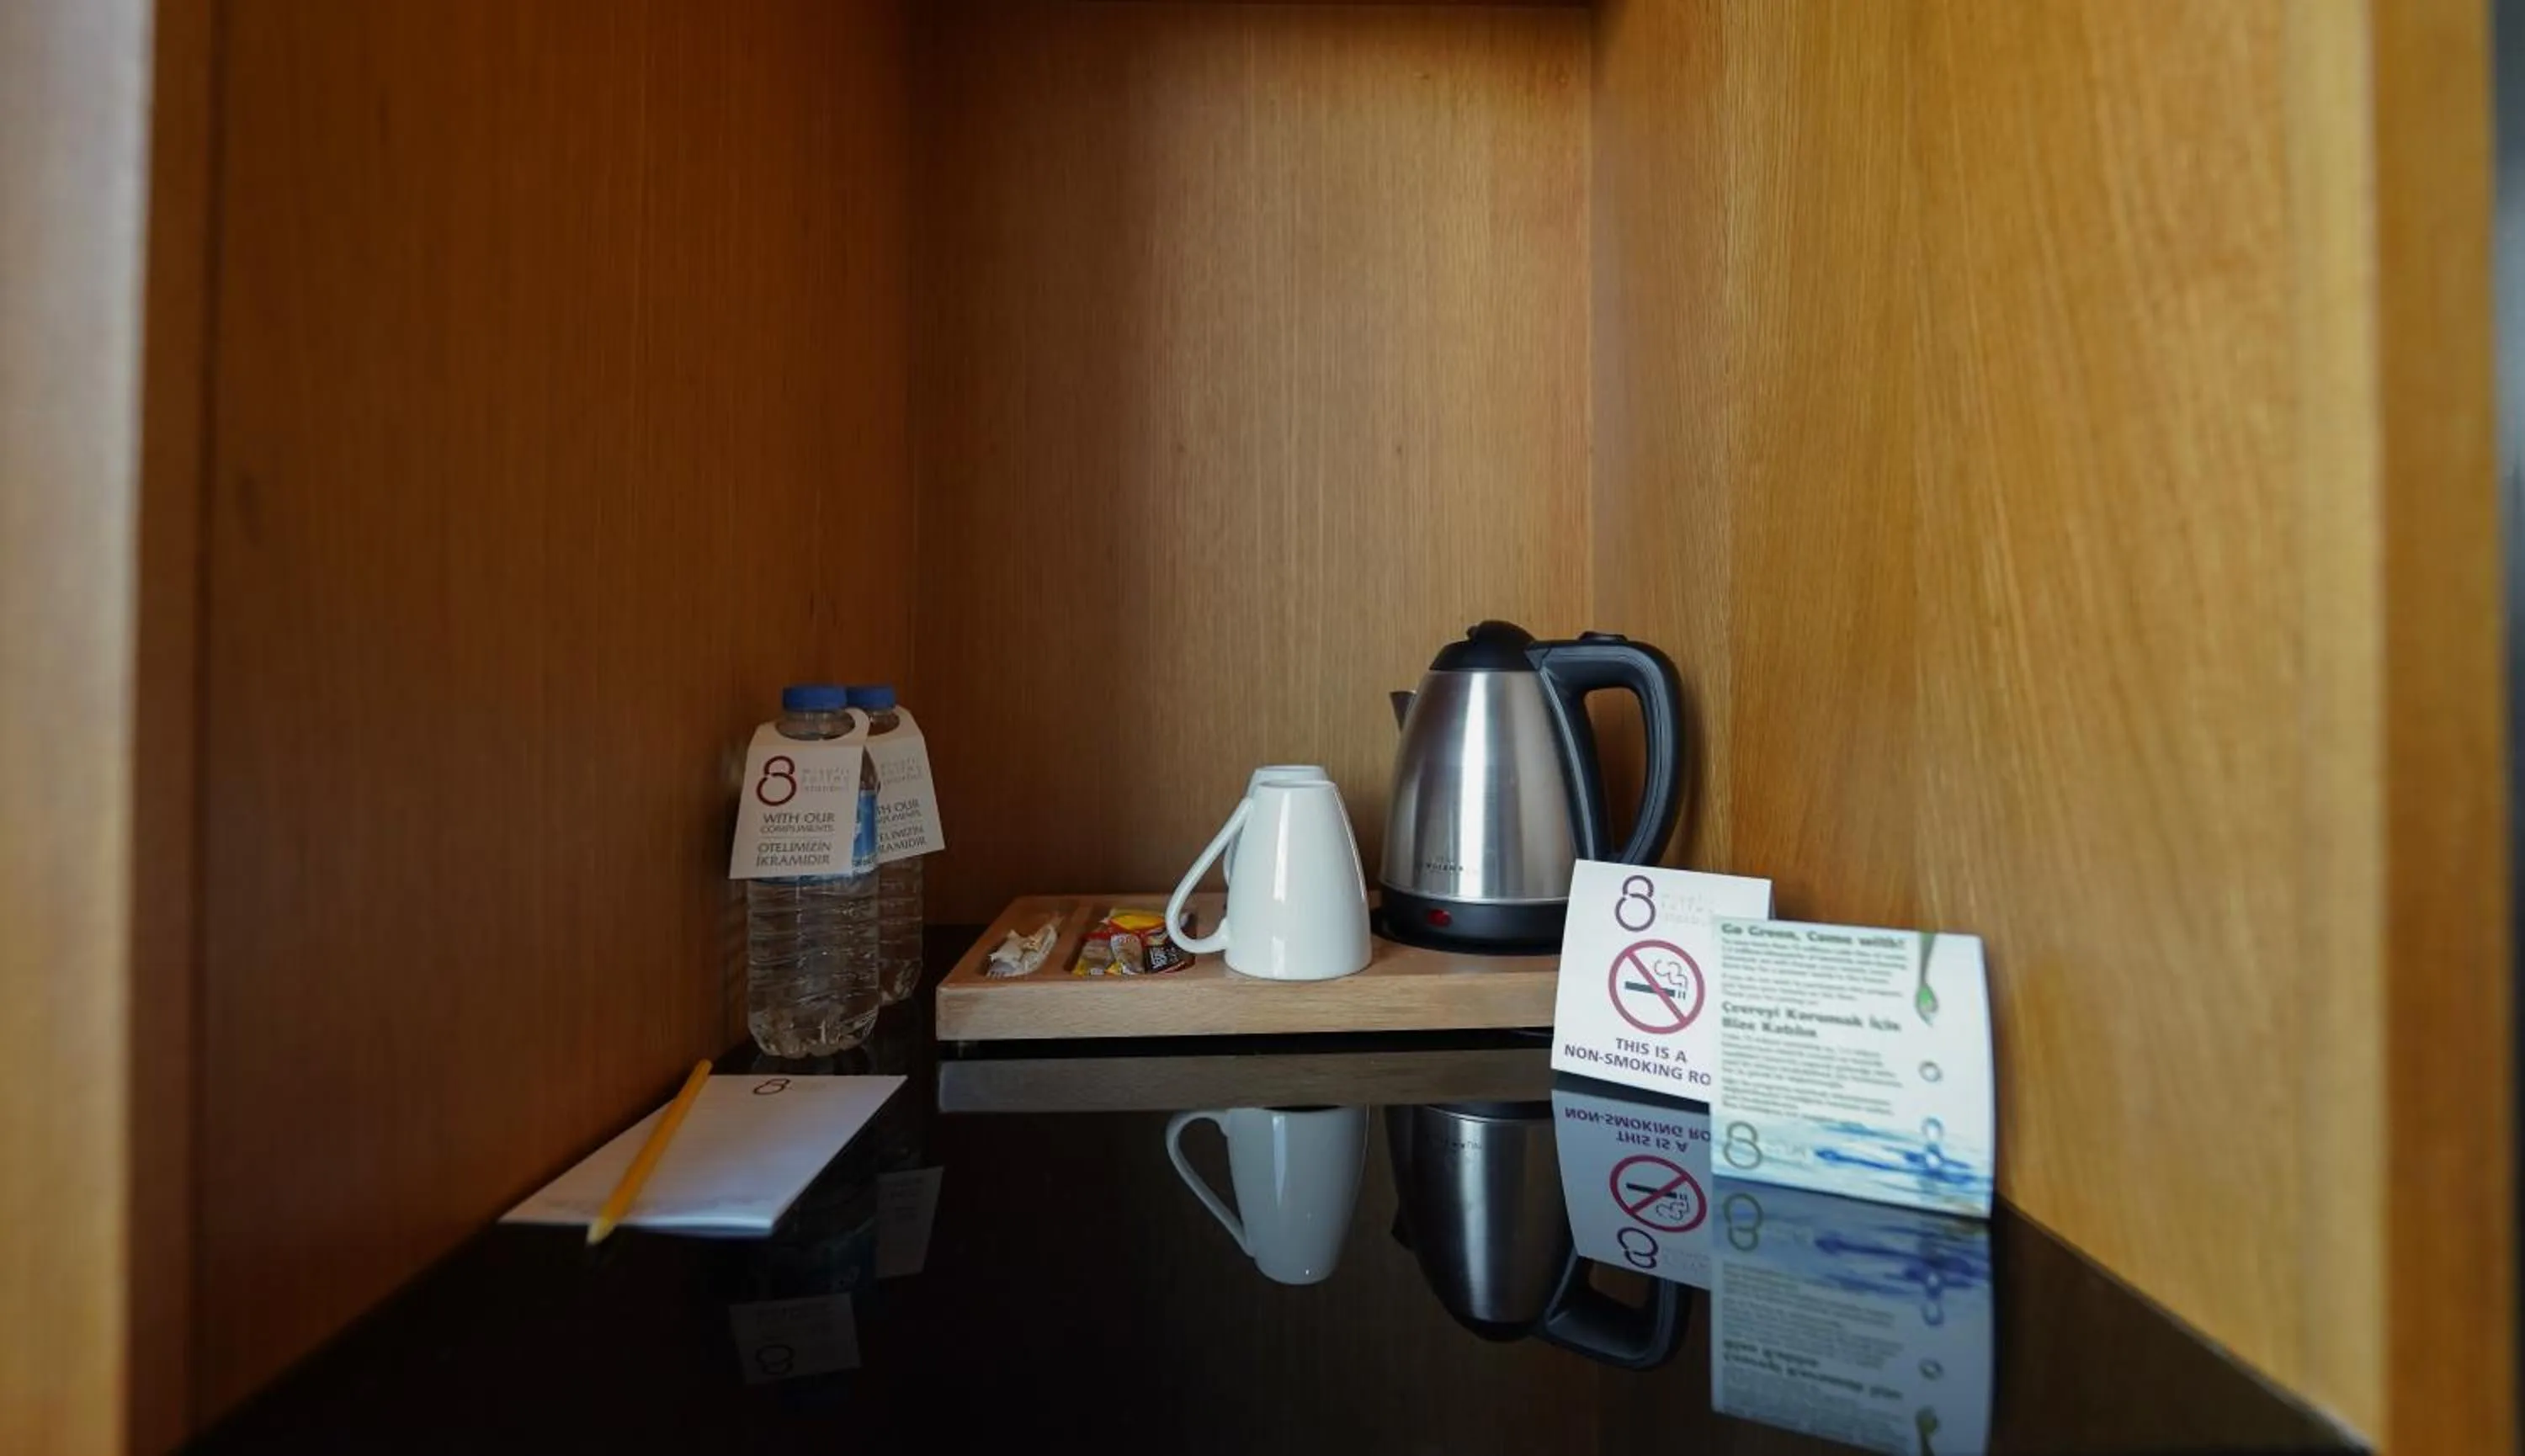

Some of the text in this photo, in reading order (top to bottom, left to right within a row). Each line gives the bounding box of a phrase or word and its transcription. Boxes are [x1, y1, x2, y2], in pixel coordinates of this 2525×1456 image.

[763, 811, 836, 824] WITH OUR
[759, 824, 836, 834] COMPLIMENTS
[1721, 923, 1742, 935] Go
[1616, 1038, 1688, 1063] THIS IS A
[1564, 1044, 1712, 1086] NON-SMOKING RO
